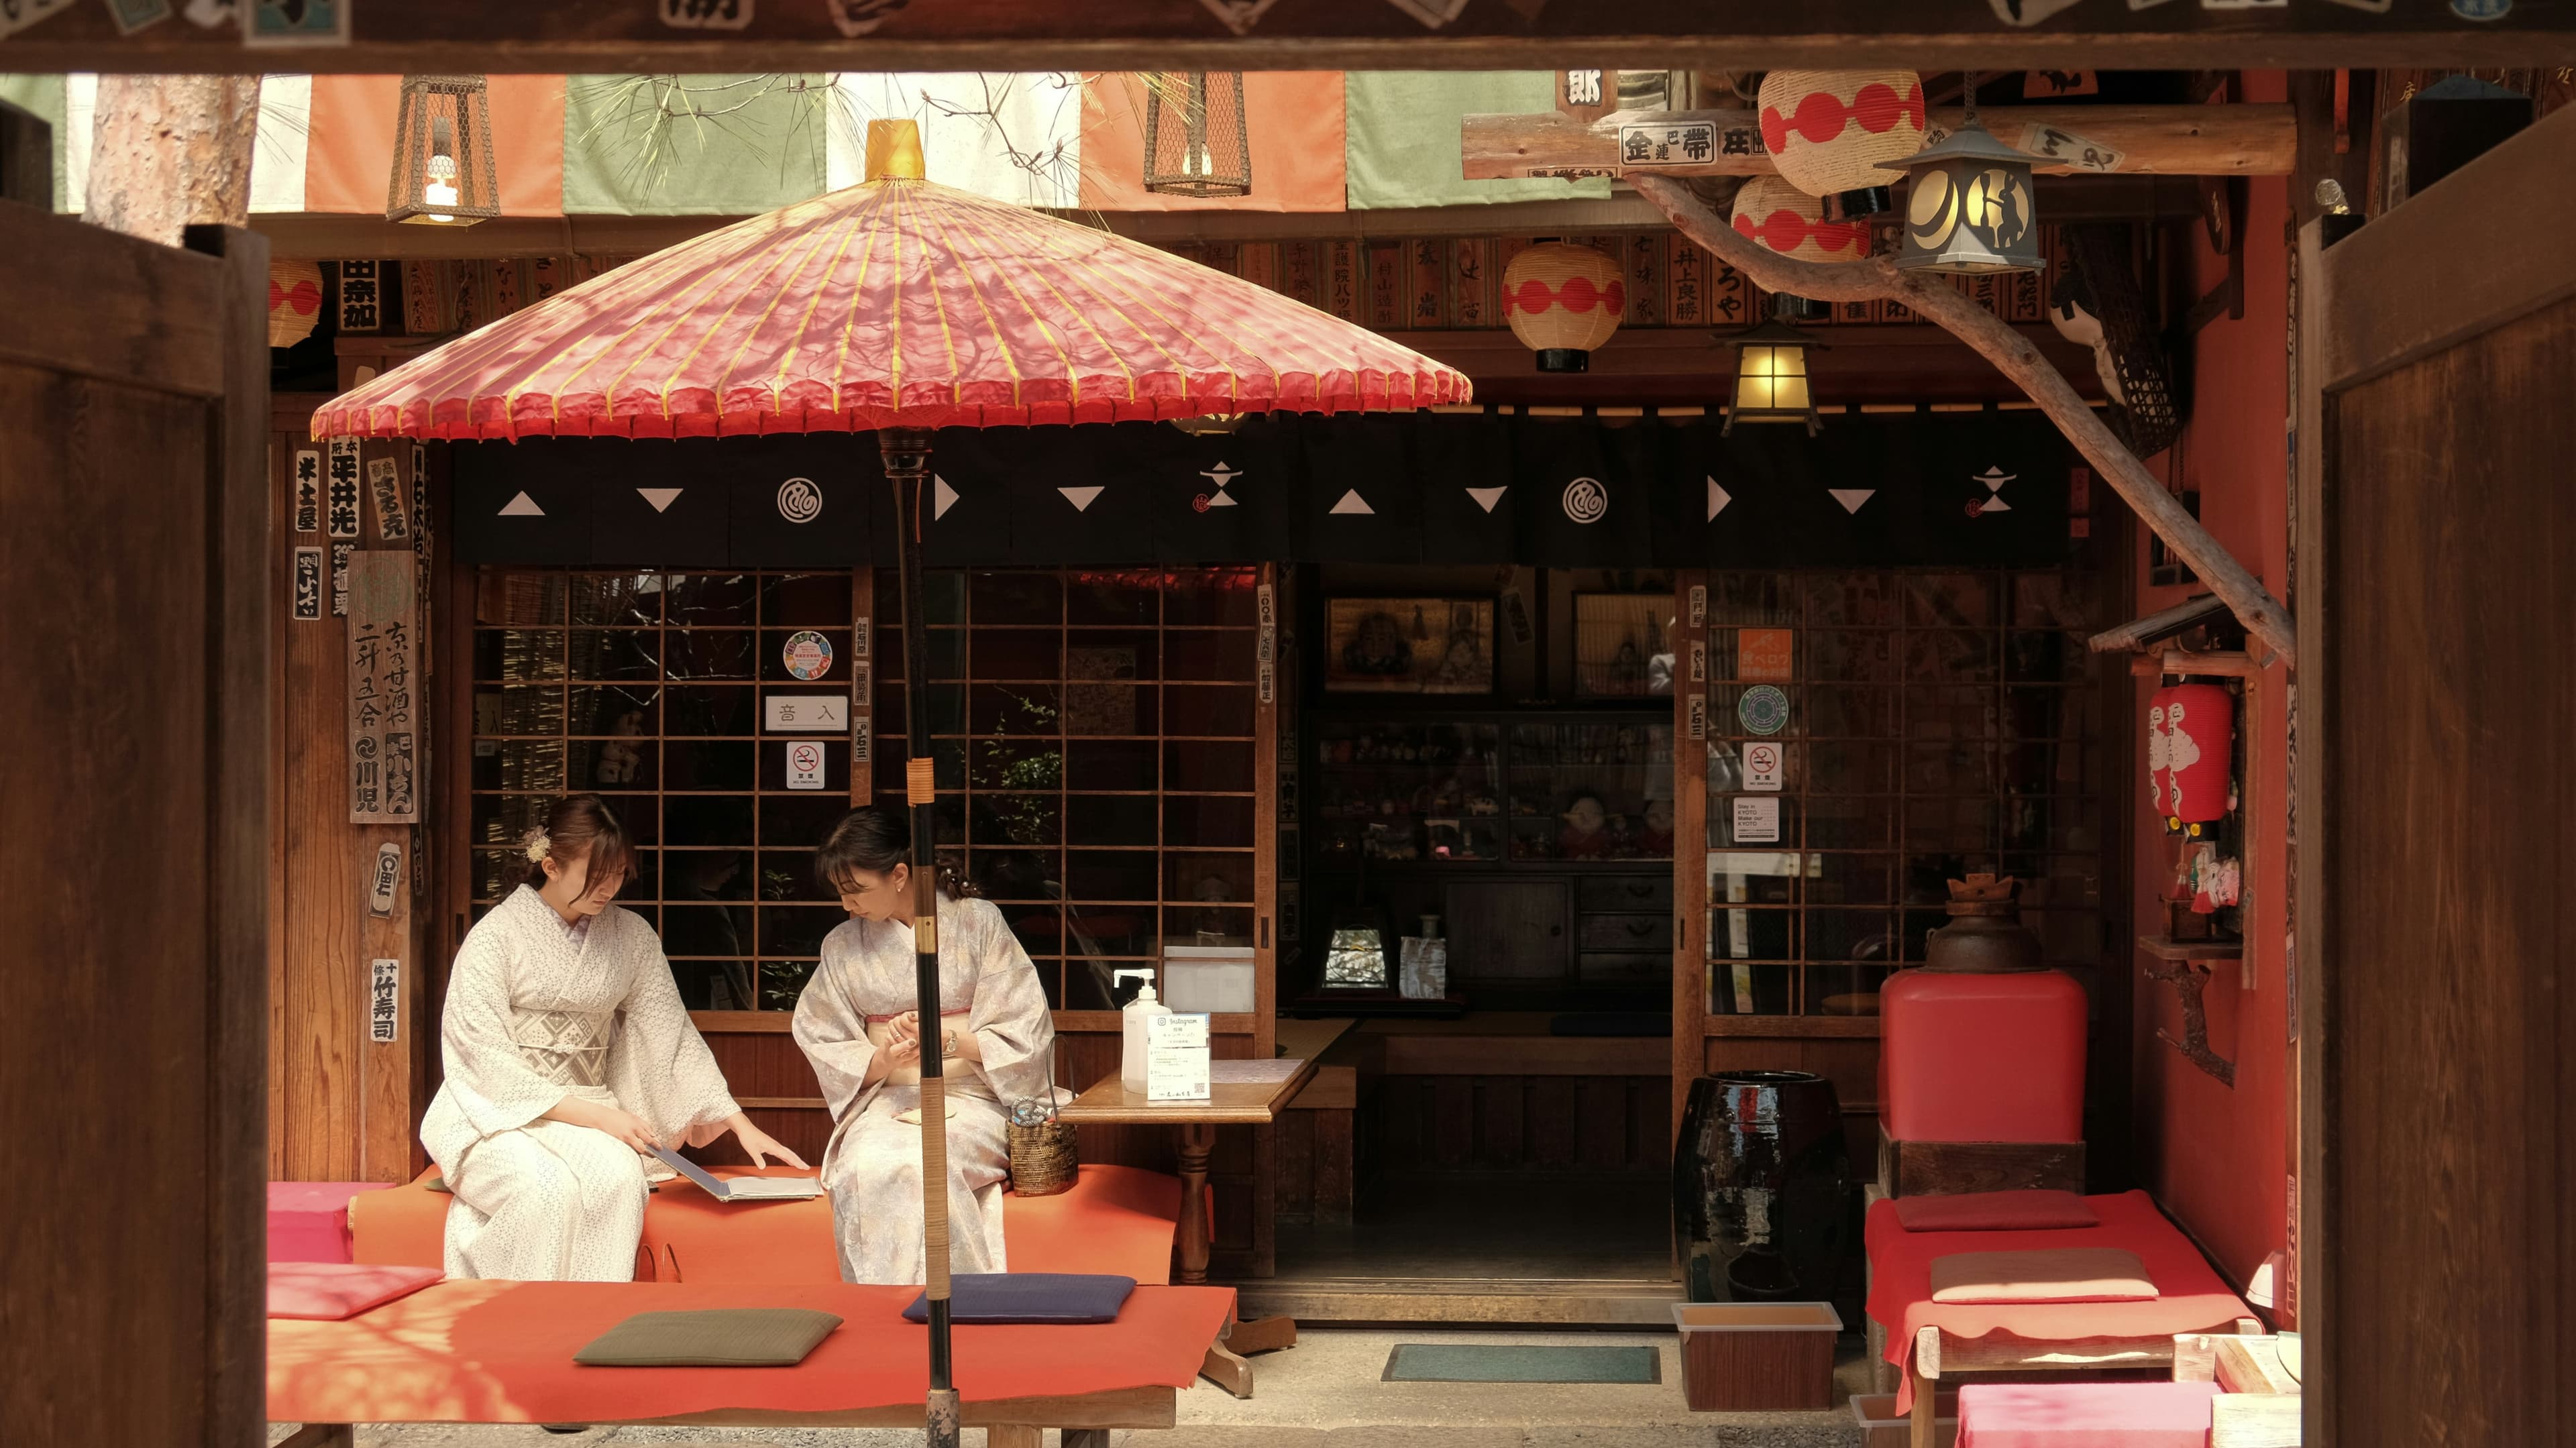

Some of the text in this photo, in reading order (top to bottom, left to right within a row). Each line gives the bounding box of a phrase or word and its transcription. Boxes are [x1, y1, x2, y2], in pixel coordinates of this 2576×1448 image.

[373, 977, 396, 1040] 竹寿司
[1169, 1017, 1197, 1026] Instagram
